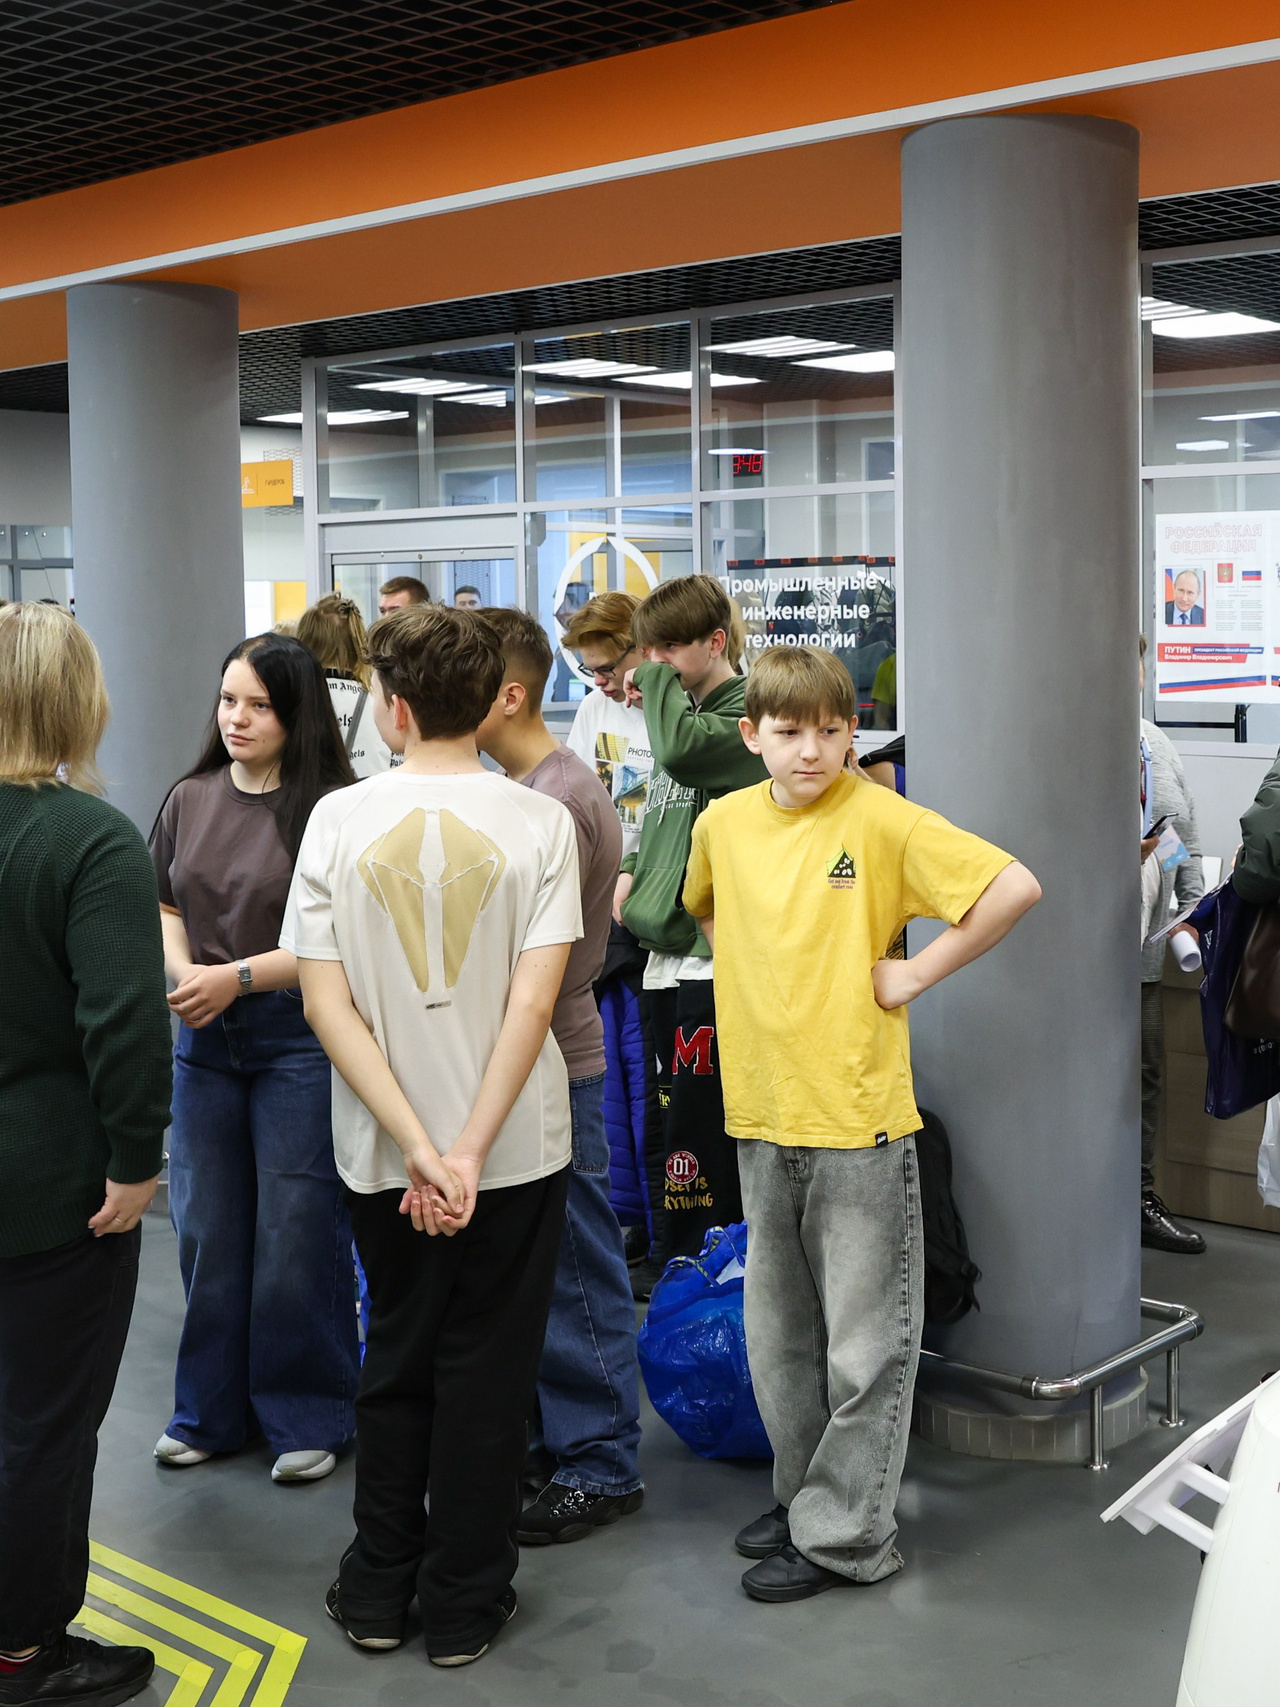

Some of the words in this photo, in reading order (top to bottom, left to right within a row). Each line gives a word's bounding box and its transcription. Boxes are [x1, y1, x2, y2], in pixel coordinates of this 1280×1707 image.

[1164, 522, 1263, 539] РОССИЙСКАЯ
[1170, 540, 1257, 554] ФЕДЕРАЦИЯ
[718, 575, 878, 597] Промышленные
[742, 603, 870, 624] инженерные
[745, 632, 856, 648] технологии
[1164, 646, 1191, 654] ПУТИН
[340, 682, 361, 694] Ange
[672, 1026, 714, 1075] M
[674, 1158, 689, 1175] 01
[664, 1193, 713, 1210] RYTHING
